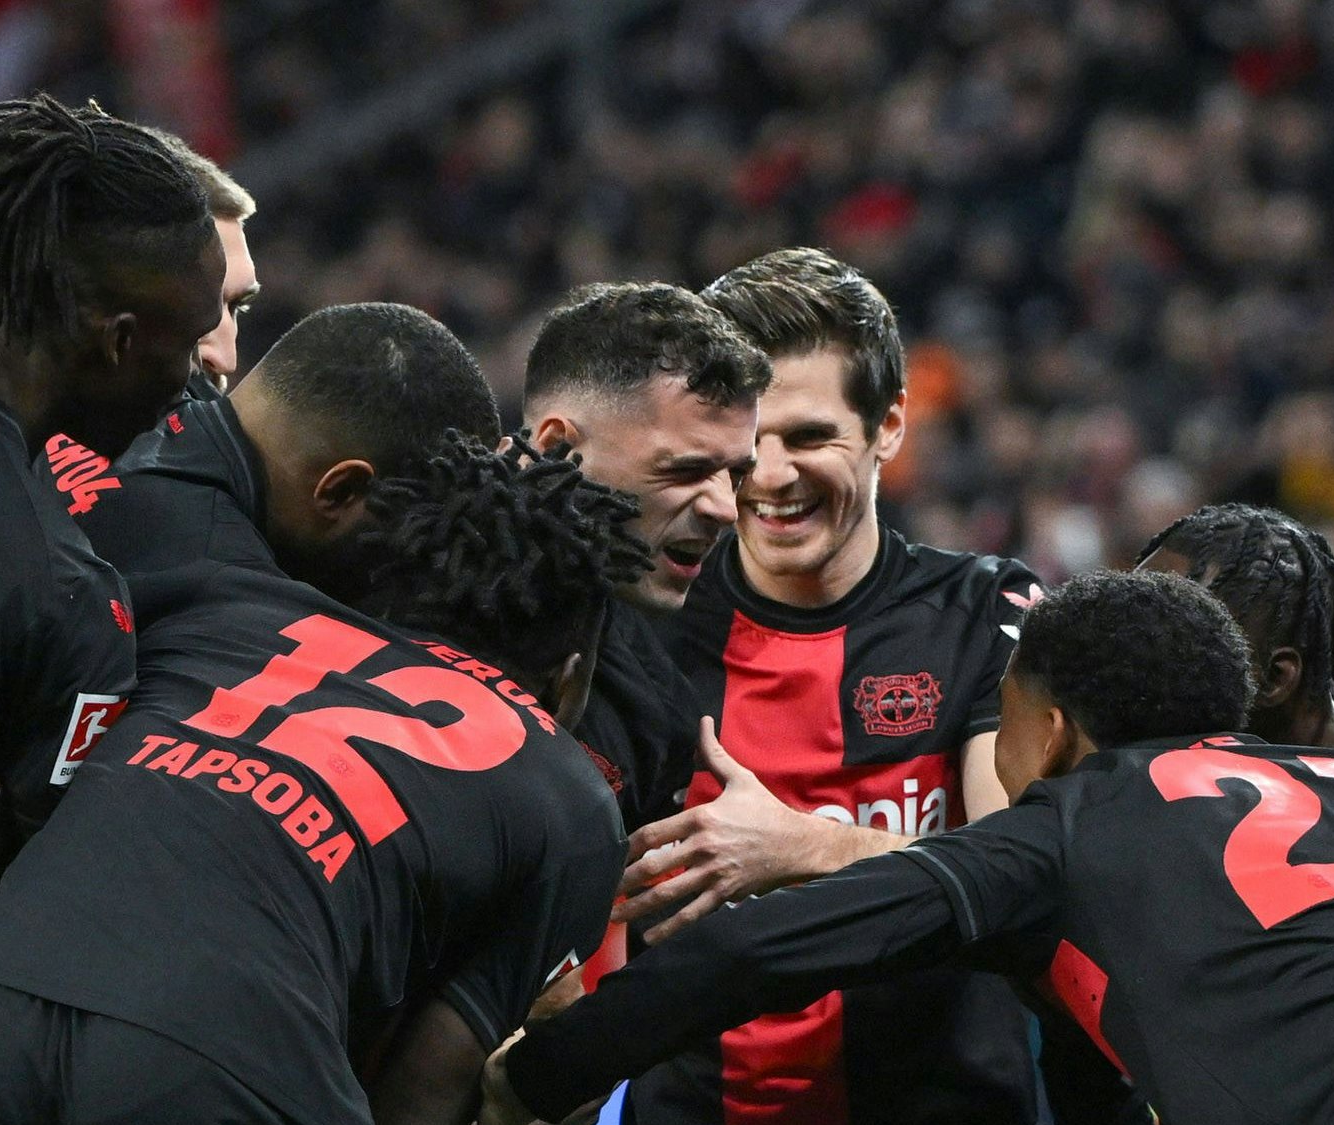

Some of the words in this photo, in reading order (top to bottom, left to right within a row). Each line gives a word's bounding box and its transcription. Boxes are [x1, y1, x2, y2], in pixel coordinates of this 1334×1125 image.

[180, 614, 527, 847] 12
[410, 638, 557, 736] ER04
[127, 733, 357, 884] TAPSOBA
